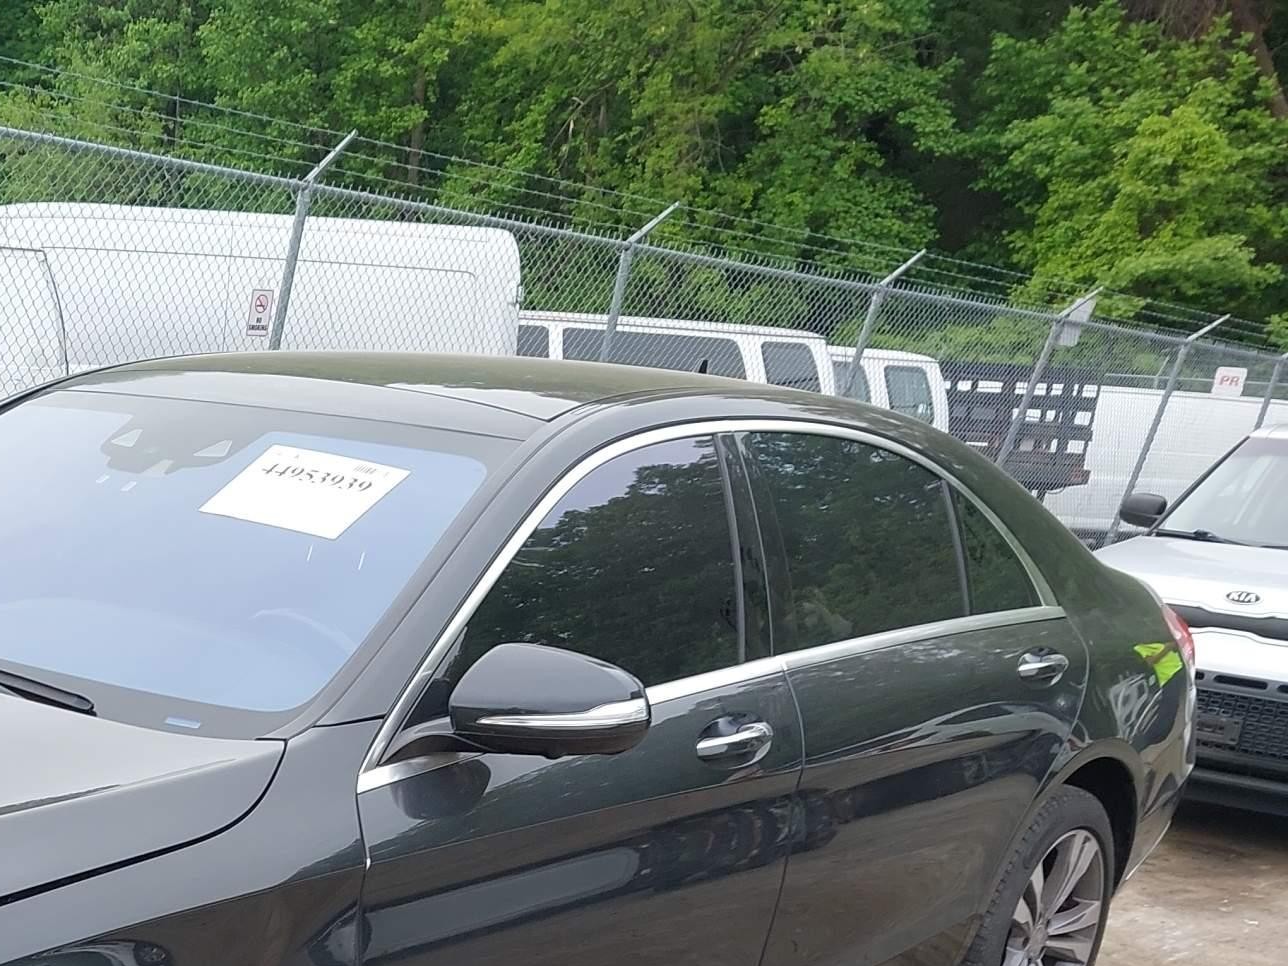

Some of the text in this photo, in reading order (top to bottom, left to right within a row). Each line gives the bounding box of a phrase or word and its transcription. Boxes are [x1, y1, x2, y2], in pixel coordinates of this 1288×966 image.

[1219, 376, 1240, 386] PR
[262, 463, 373, 492] 44953939
[1228, 591, 1260, 603] KIA
